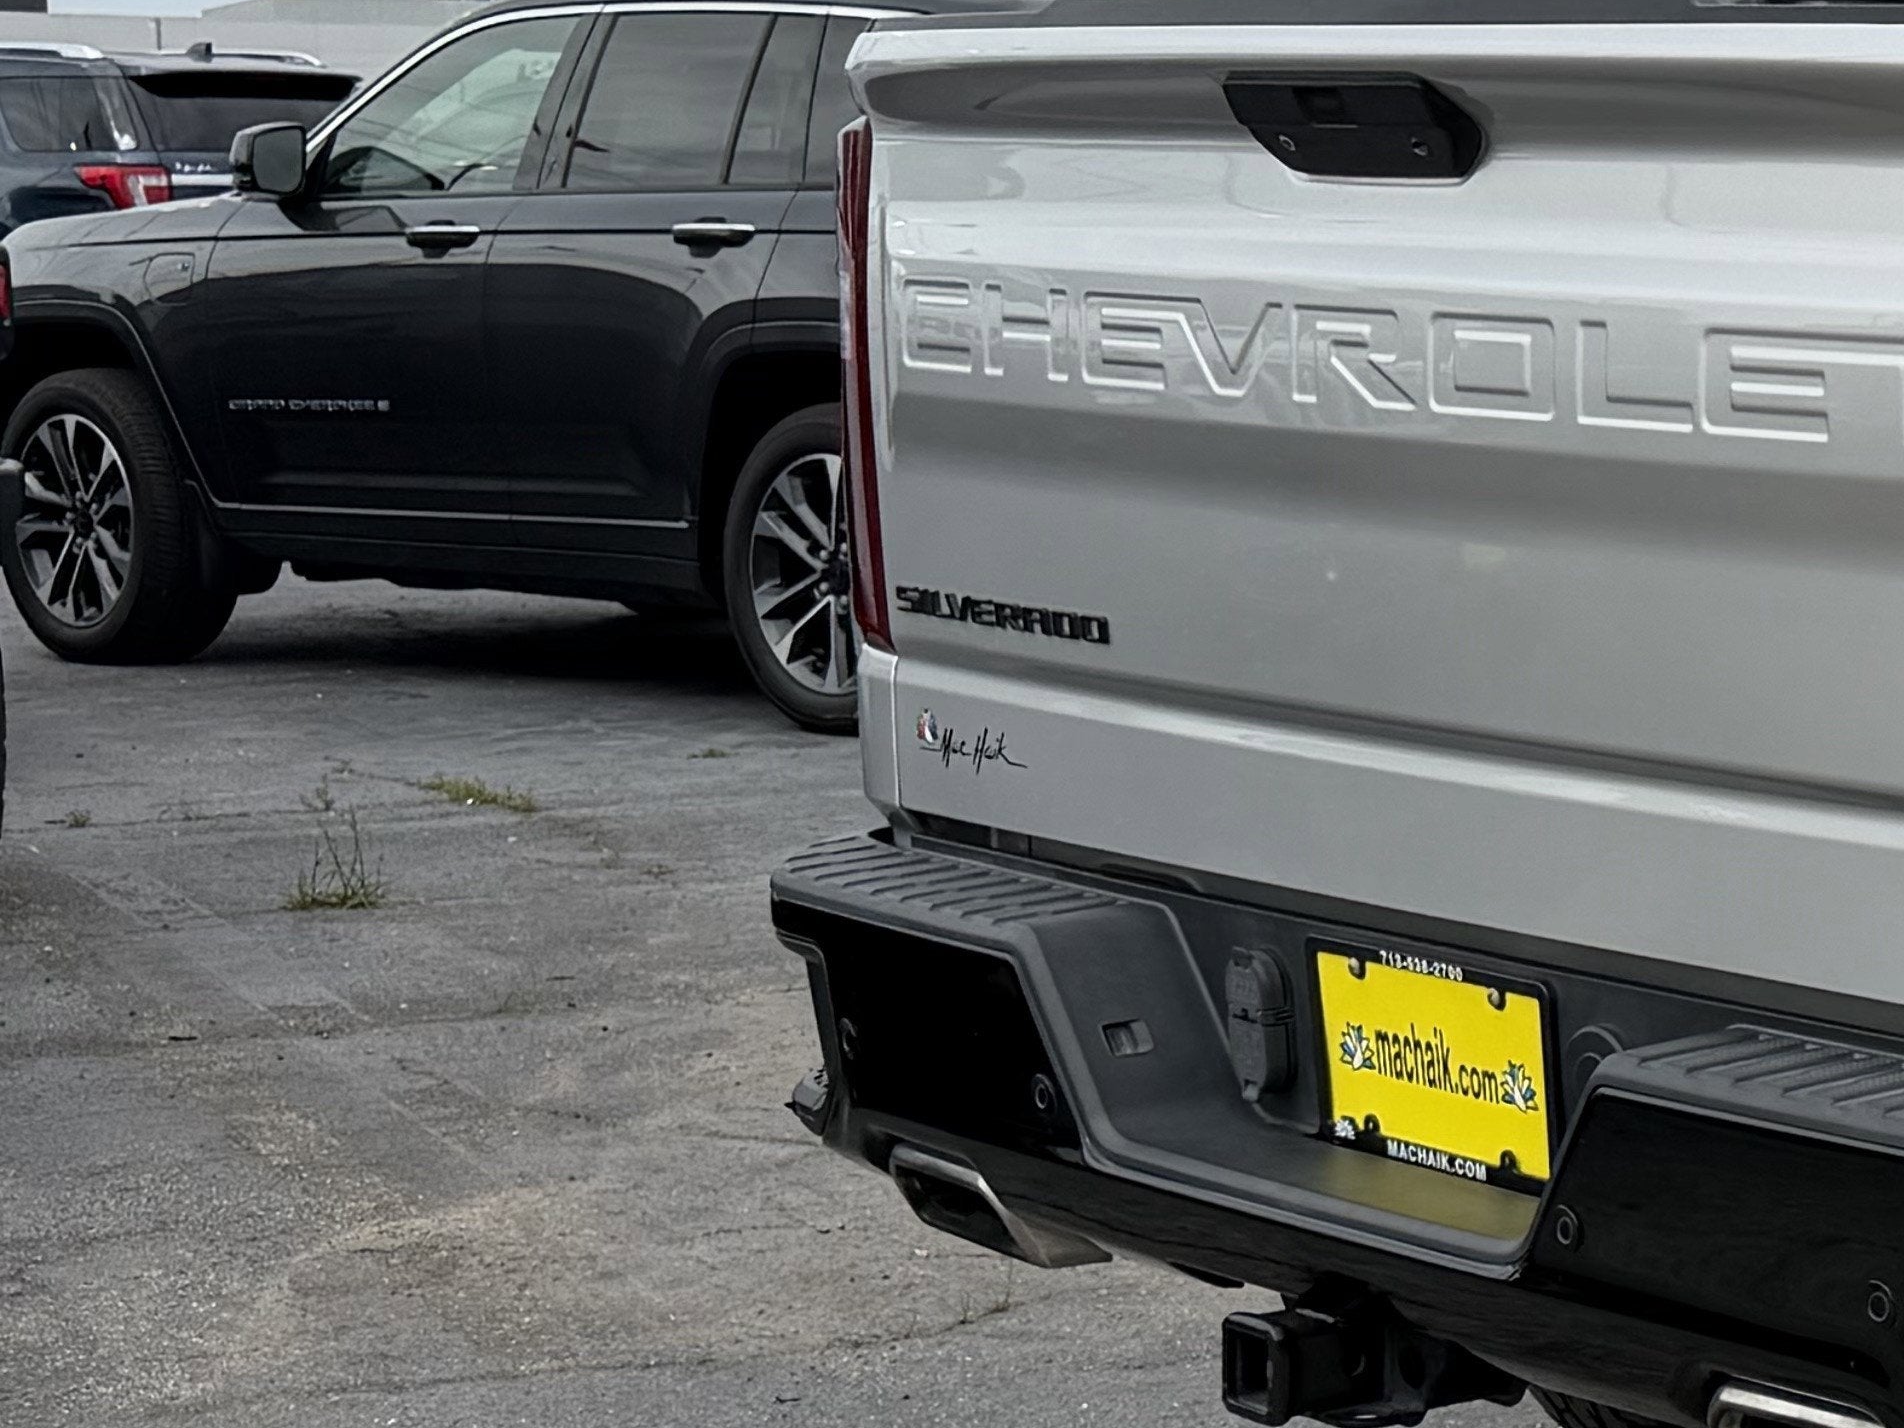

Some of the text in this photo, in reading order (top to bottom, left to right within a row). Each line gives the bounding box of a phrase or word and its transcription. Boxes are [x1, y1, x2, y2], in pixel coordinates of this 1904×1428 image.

[896, 585, 1111, 645] SILVERADO
[1375, 1022, 1500, 1104] machaik.com
[1386, 1139, 1487, 1182] MACHAIK.COM
